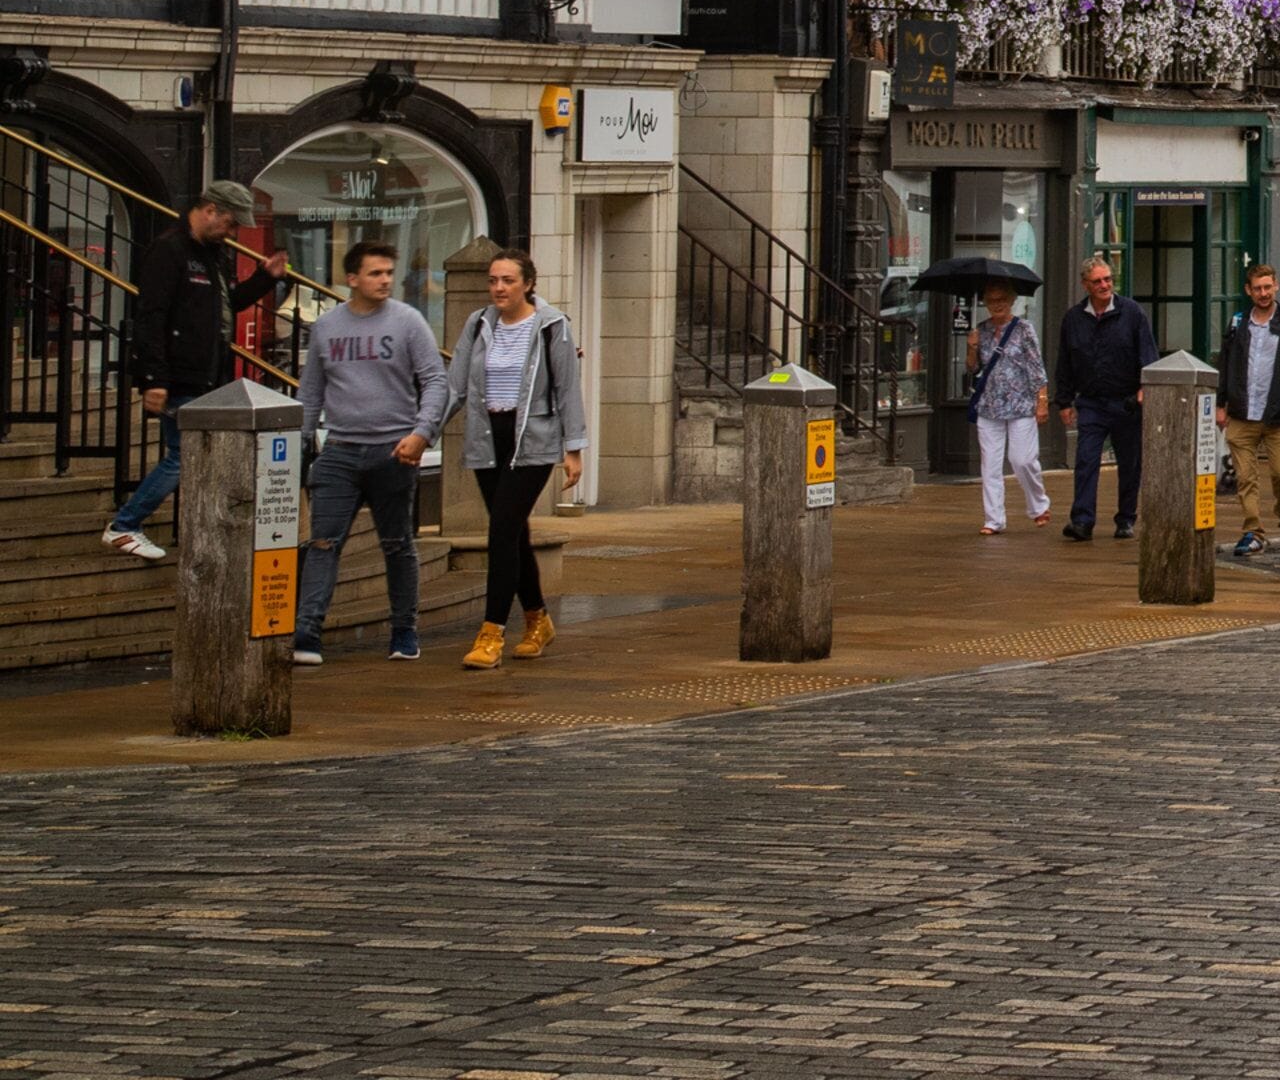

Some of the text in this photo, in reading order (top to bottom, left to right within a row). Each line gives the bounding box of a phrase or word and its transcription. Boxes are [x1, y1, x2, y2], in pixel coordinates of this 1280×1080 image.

[600, 96, 658, 143] POUR Moi
[908, 121, 1041, 149] MODA IN PELLE
[349, 170, 377, 199] Moi?
[329, 335, 394, 361] WILLS
[274, 440, 285, 460] P
